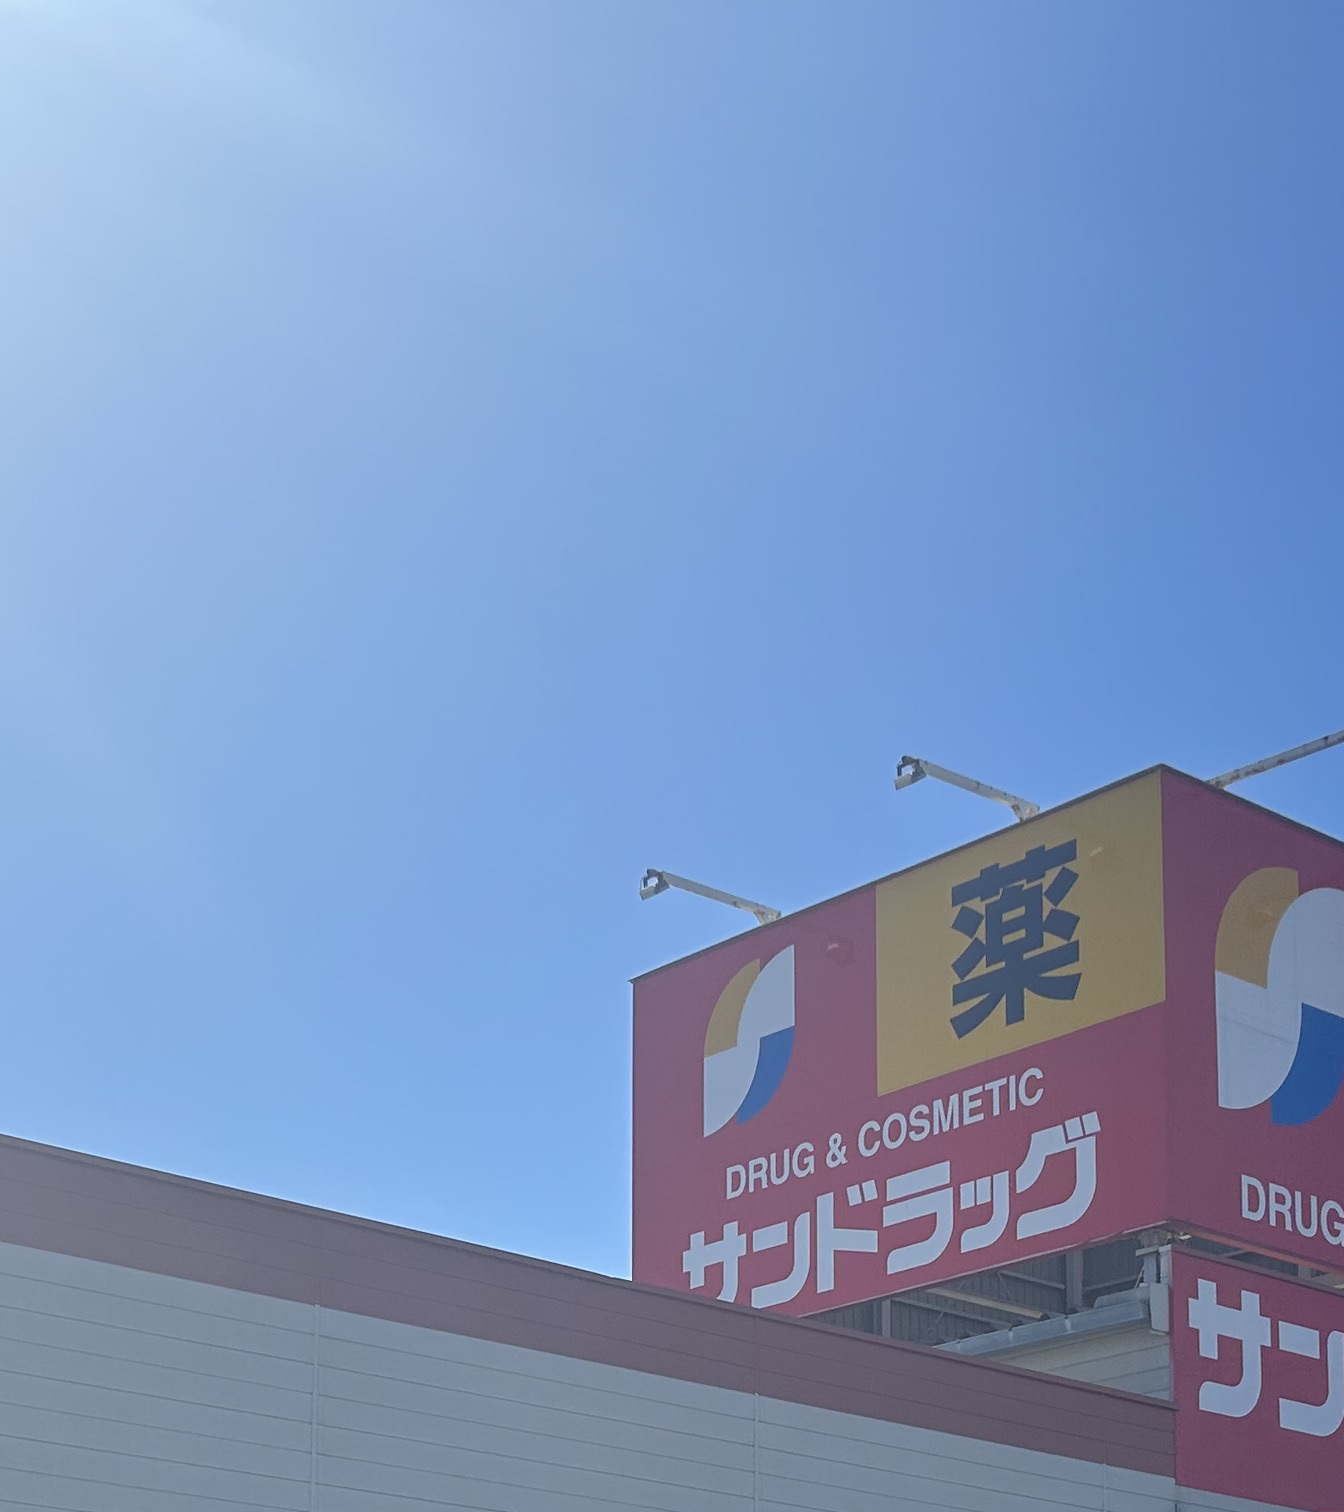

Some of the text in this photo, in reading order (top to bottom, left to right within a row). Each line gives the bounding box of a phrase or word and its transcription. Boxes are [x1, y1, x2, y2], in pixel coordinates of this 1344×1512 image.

[949, 838, 1082, 1040] 薬
[682, 1111, 1101, 1309] サンドラッグ
[726, 1067, 1044, 1199] DRUG & COSMETIC
